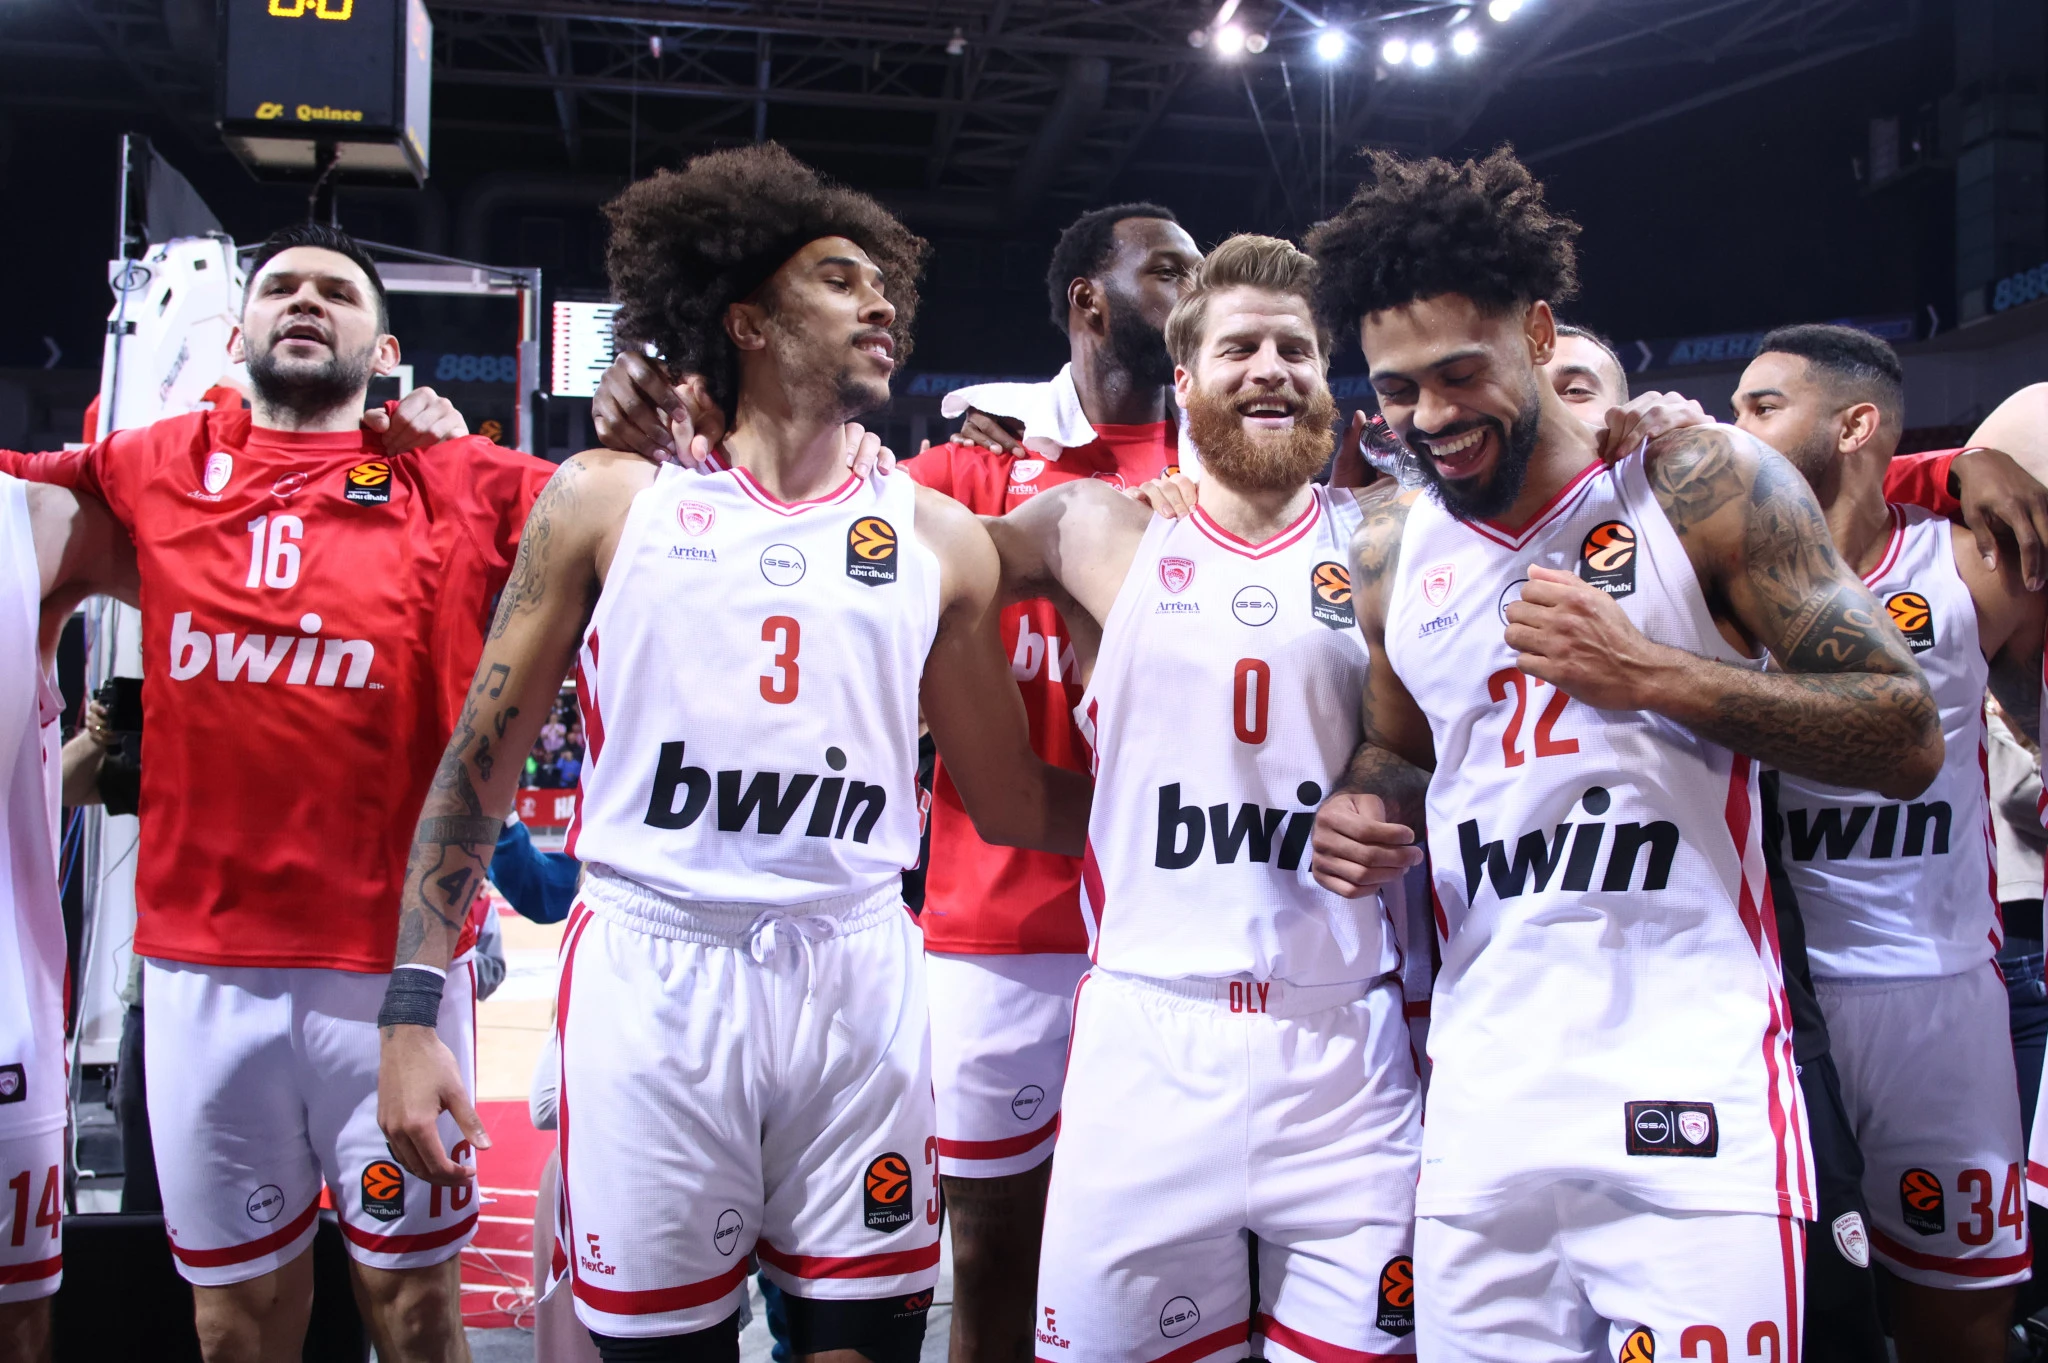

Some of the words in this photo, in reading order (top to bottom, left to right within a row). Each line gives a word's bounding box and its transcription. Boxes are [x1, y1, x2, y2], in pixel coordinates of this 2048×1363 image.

[296, 104, 363, 122] Quince
[245, 514, 304, 589] 16
[763, 558, 802, 570] GSA
[850, 567, 868, 577] abu
[868, 569, 894, 580] dhabi
[1235, 601, 1274, 609] GSA
[1314, 610, 1329, 620] abu
[1330, 613, 1353, 625] dhabi
[1816, 608, 1876, 664] 210
[169, 610, 376, 689] bwin
[759, 615, 801, 705] 3
[1233, 657, 1271, 745] 0
[1487, 666, 1580, 769] 22
[643, 740, 887, 845] bwin
[1154, 780, 1322, 871] bwi
[1778, 800, 1953, 862] win
[1229, 981, 1270, 1013] OLY
[1638, 1122, 1667, 1130] GSA
[9, 1164, 62, 1247] 14
[249, 1194, 283, 1213] GSA
[1957, 1162, 2024, 1246] 34
[868, 1215, 886, 1225] abu
[886, 1211, 911, 1223] dhabi
[716, 1224, 741, 1240] GSA
[581, 1255, 616, 1276] FlexCar
[1162, 1310, 1197, 1326] GSA
[1379, 1318, 1396, 1327] abu
[1036, 1328, 1070, 1350] FlexCar
